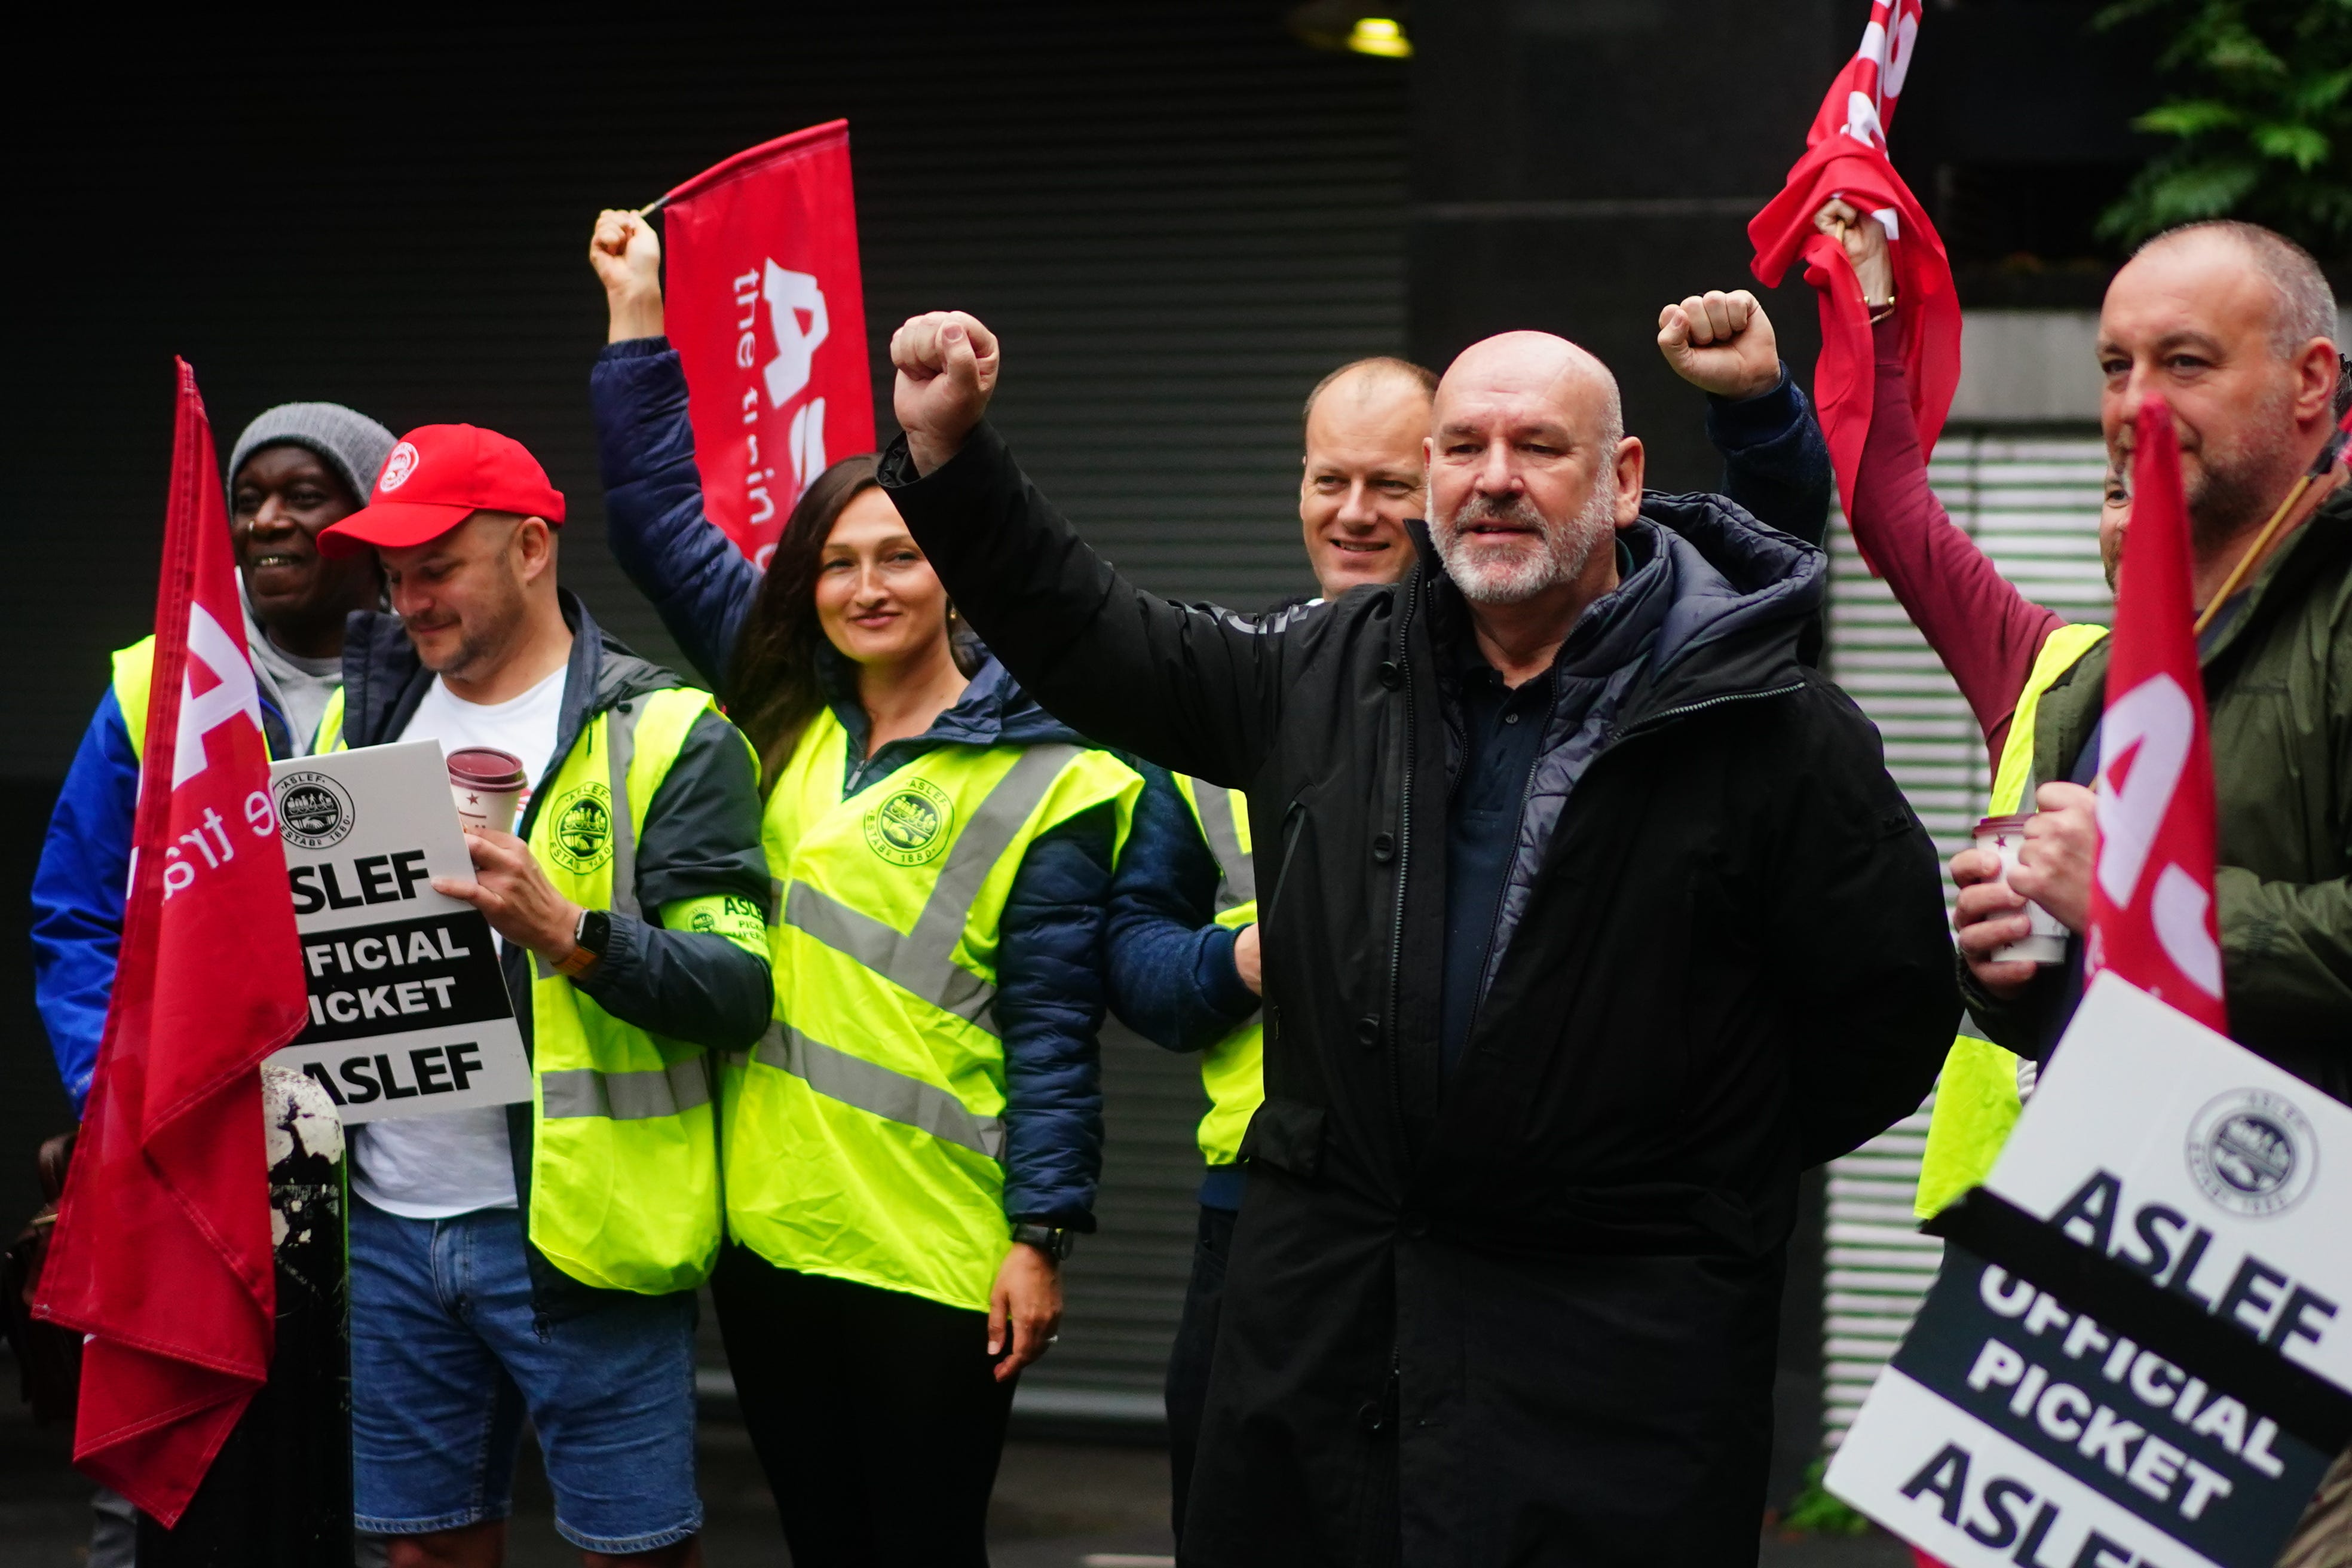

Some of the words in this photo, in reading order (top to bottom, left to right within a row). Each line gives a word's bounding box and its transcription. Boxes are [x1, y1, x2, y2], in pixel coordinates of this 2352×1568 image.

[909, 779, 948, 805] ASLEF
[901, 849, 933, 863] 1880
[287, 849, 430, 915] SLEF
[302, 927, 471, 977] FICIAL
[308, 976, 457, 1027] ICKET
[1966, 1337, 2234, 1522] PICKET
